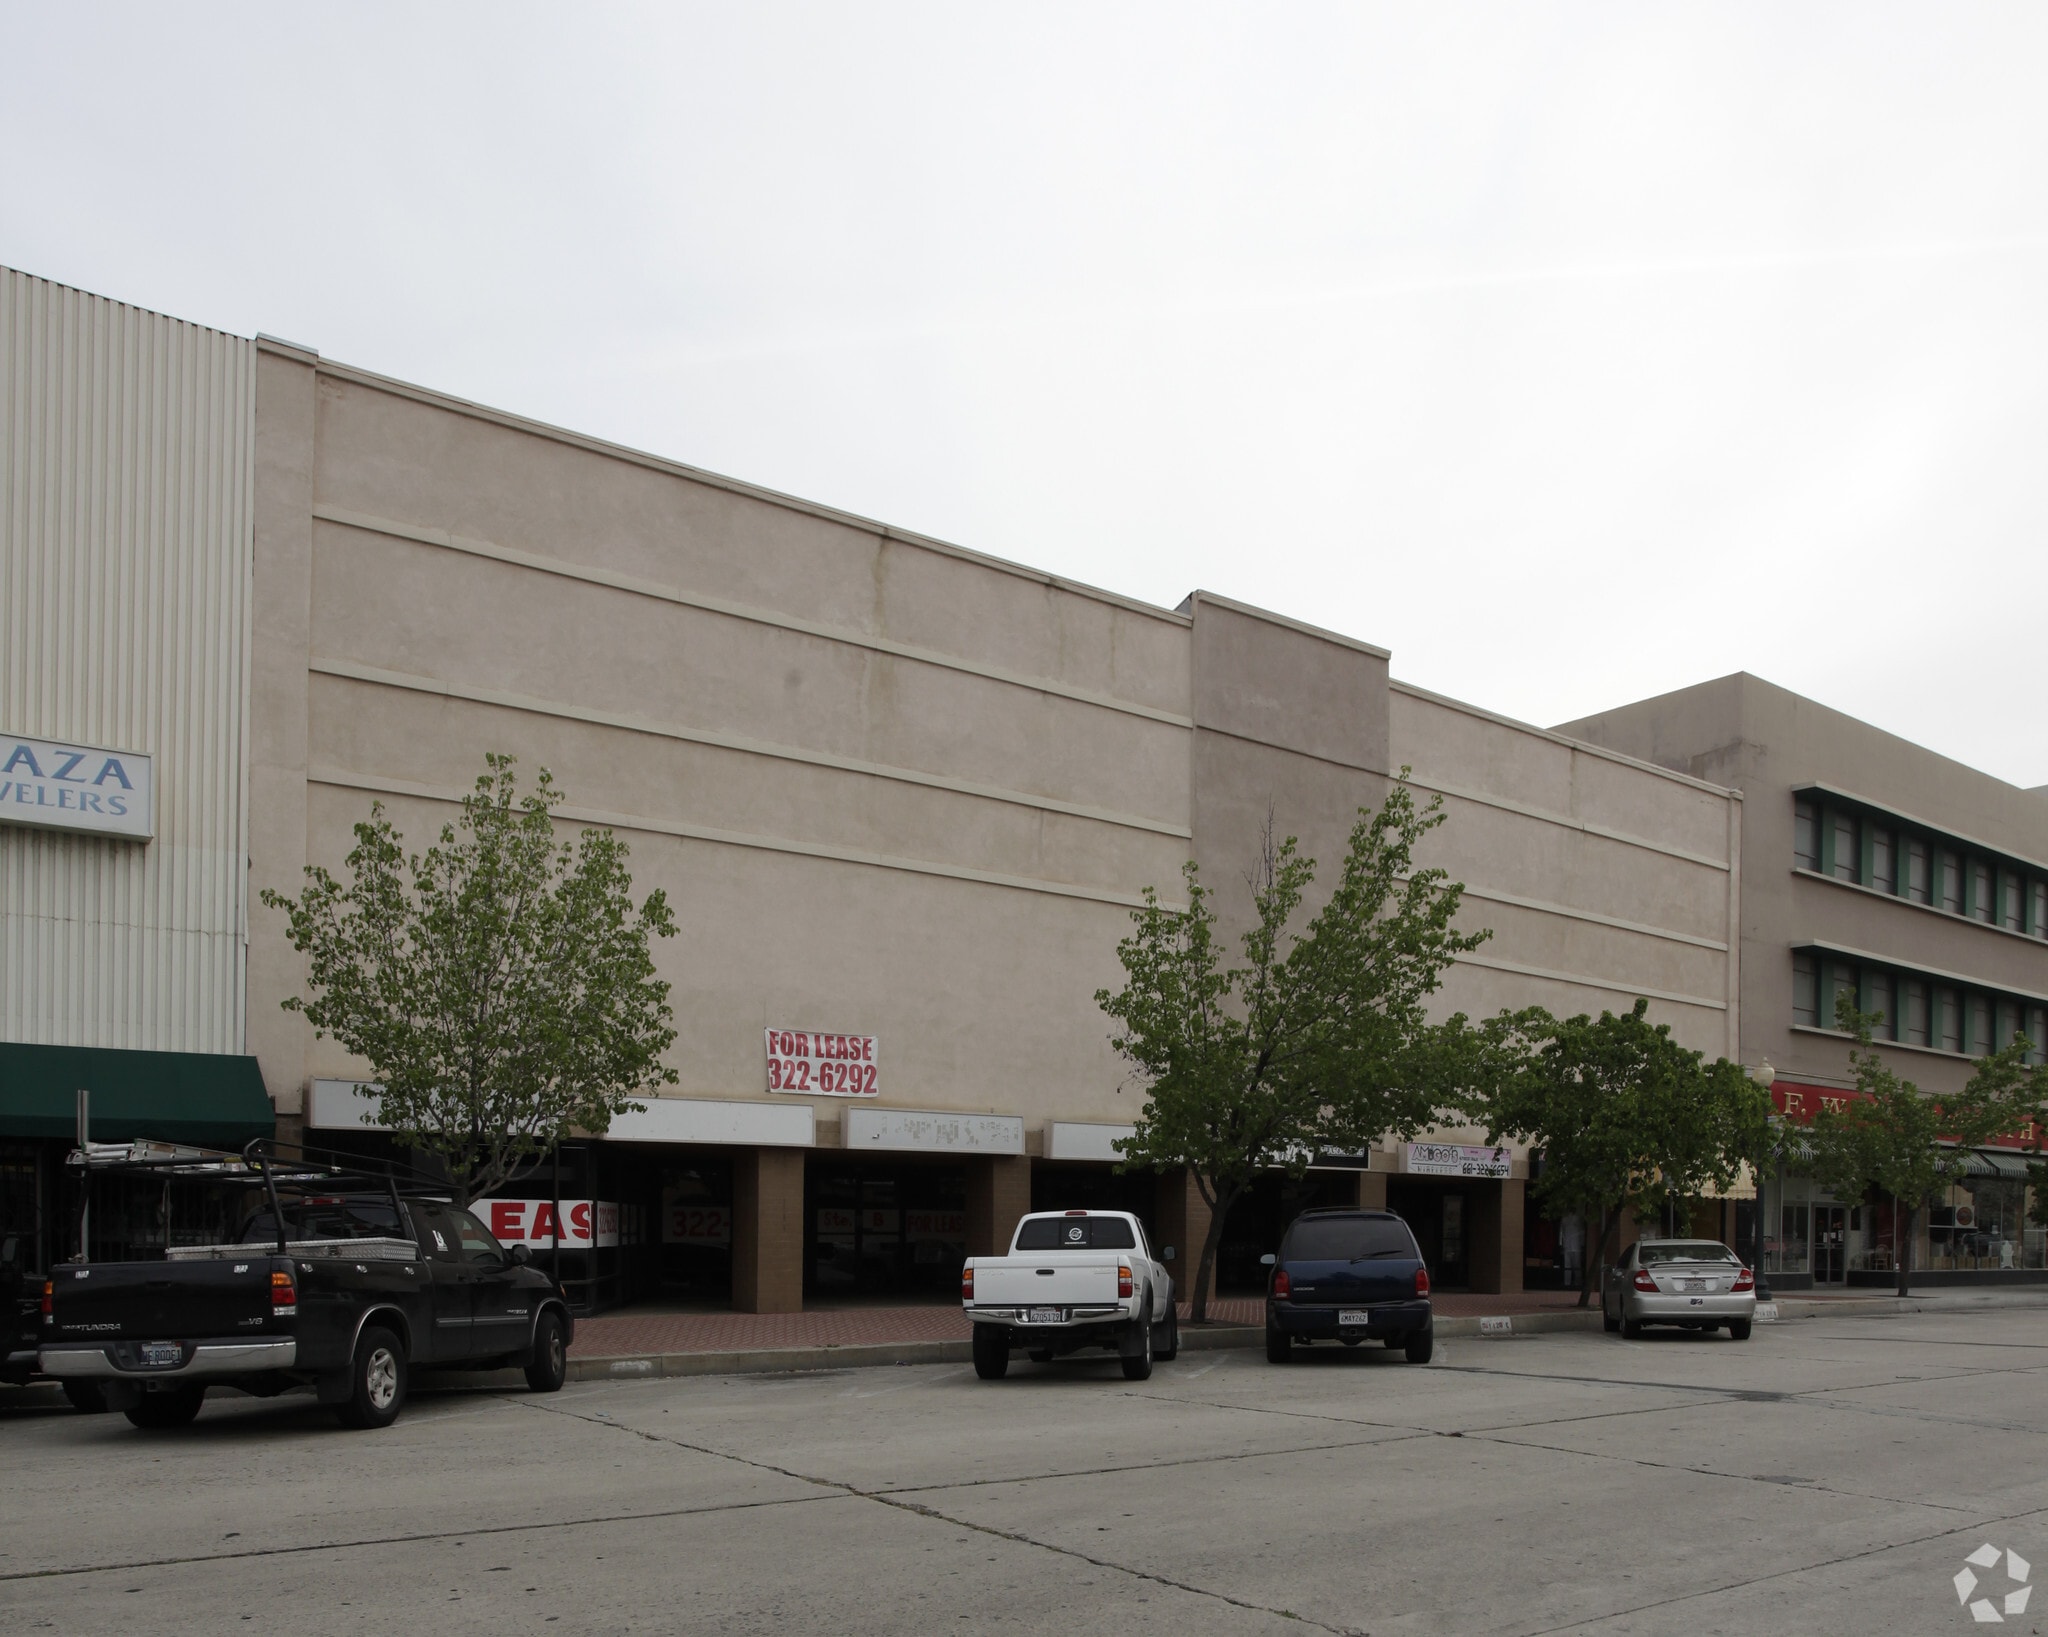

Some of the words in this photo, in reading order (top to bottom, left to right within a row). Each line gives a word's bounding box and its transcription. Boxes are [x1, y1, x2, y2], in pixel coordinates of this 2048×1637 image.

[1, 745, 135, 790] AZA
[769, 1031, 809, 1057] FOR
[815, 1035, 872, 1061] LEASE
[768, 1058, 877, 1094] 322-6292
[1784, 1092, 1807, 1115] F.
[873, 1212, 884, 1227] B
[80, 1323, 121, 1331] TUNDRA
